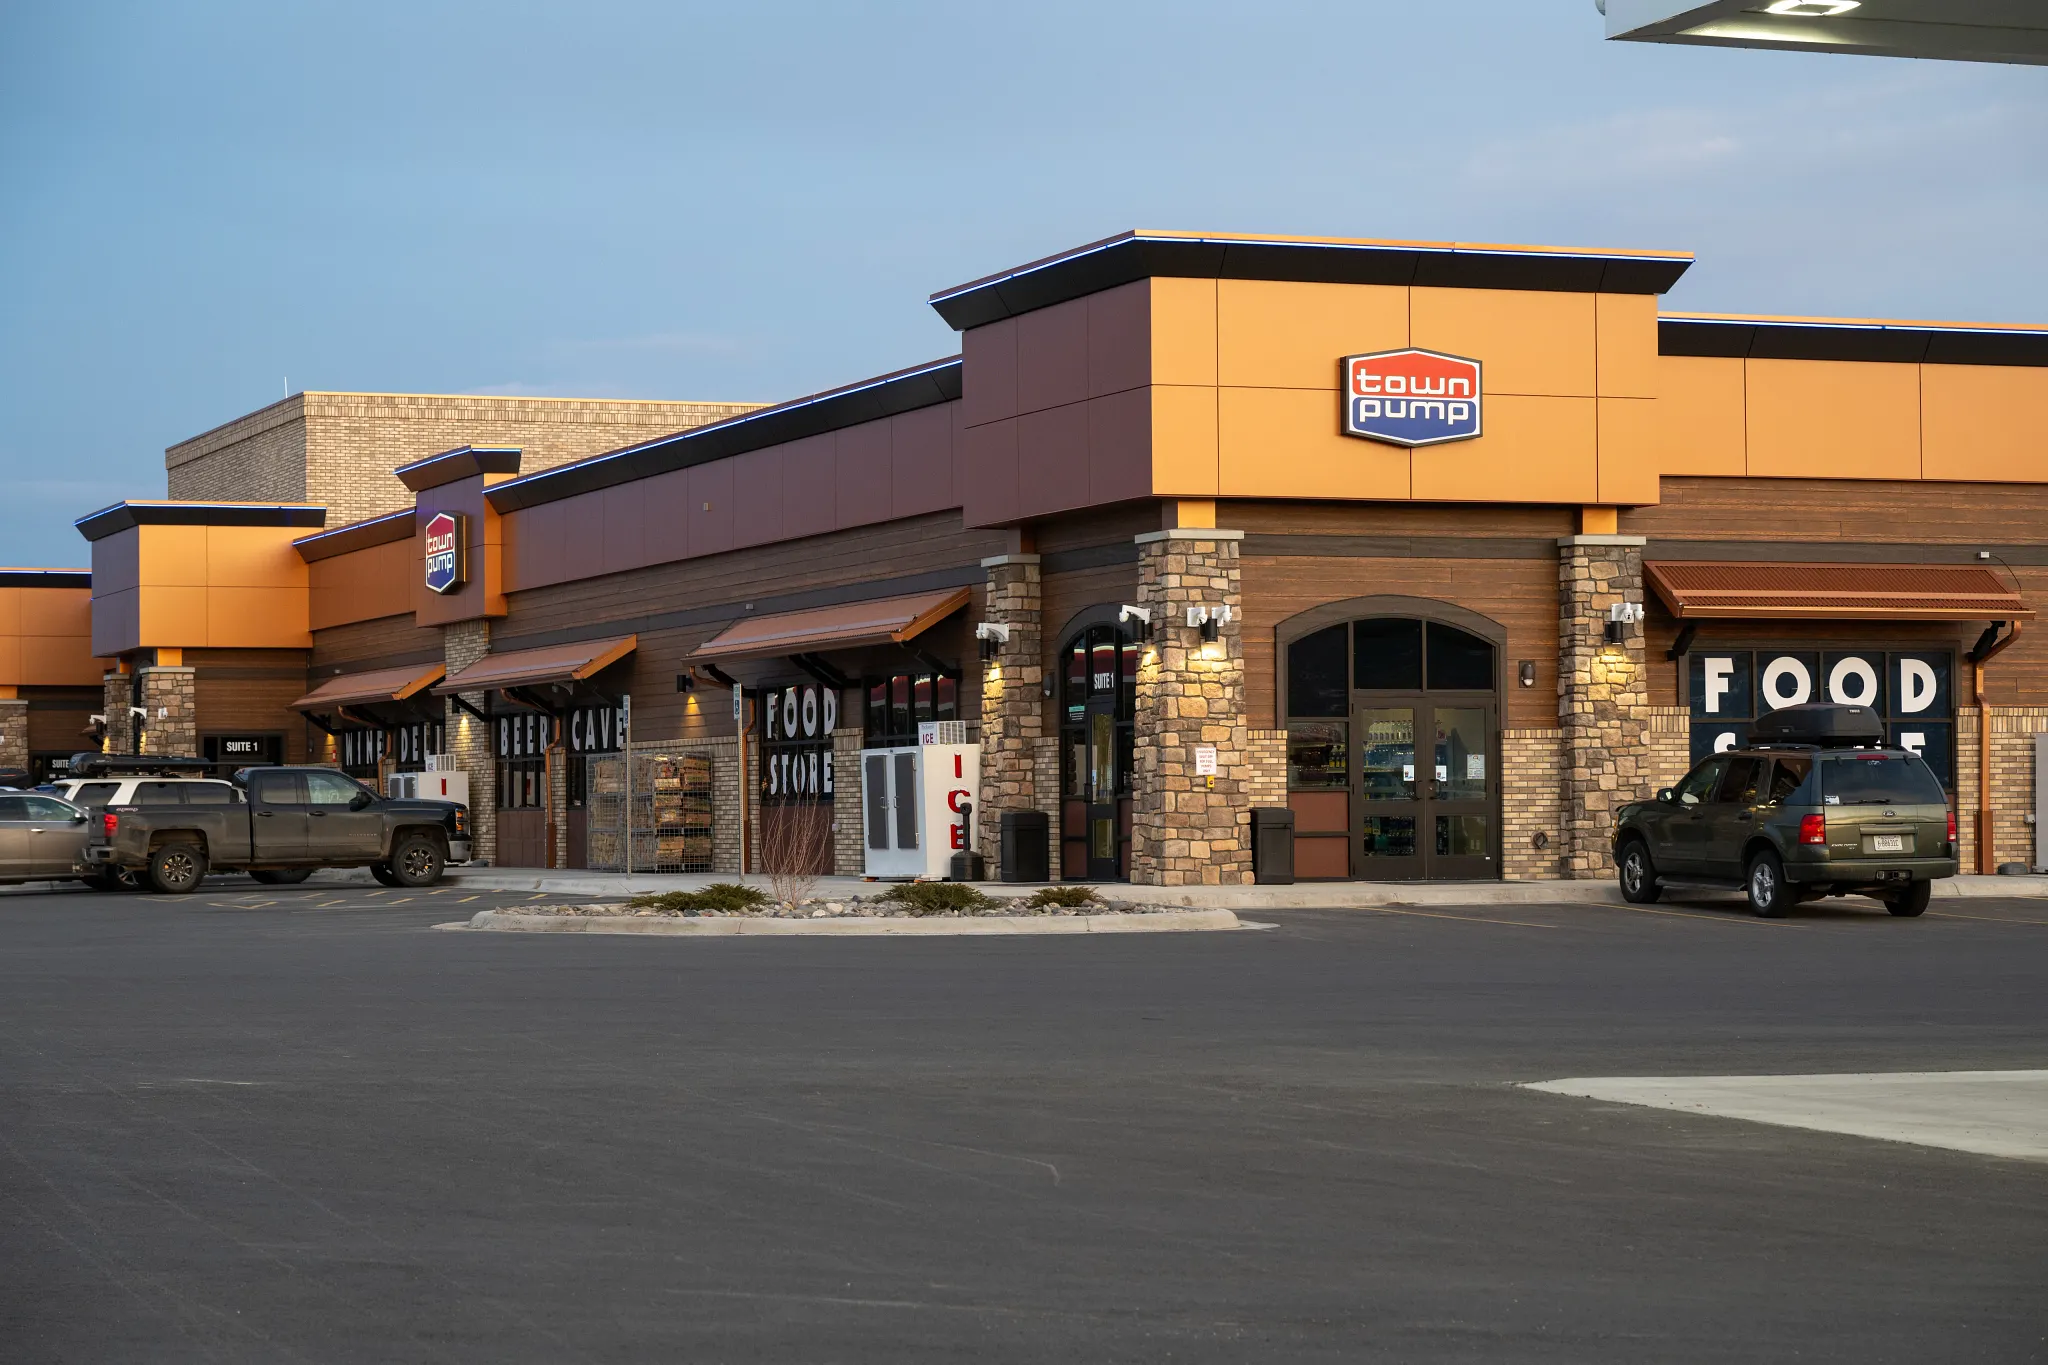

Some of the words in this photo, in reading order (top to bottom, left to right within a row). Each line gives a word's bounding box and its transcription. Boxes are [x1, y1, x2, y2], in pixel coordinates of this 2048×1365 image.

[1356, 368, 1470, 396] town
[1359, 399, 1469, 425] pump
[427, 532, 453, 553] town
[427, 553, 453, 578] pump
[1094, 673, 1109, 689] SUITE
[1111, 672, 1114, 688] 1
[1704, 656, 1937, 713] FOOD
[766, 687, 836, 739] FOOD
[500, 715, 548, 756] BEER
[571, 707, 624, 751] CAVE
[922, 733, 934, 744] ICE
[226, 741, 251, 752] SUITE
[252, 741, 258, 752] 1
[345, 730, 383, 766] WINE
[400, 724, 440, 762] DELI
[52, 759, 70, 769] SUITE
[770, 751, 833, 795] STORE
